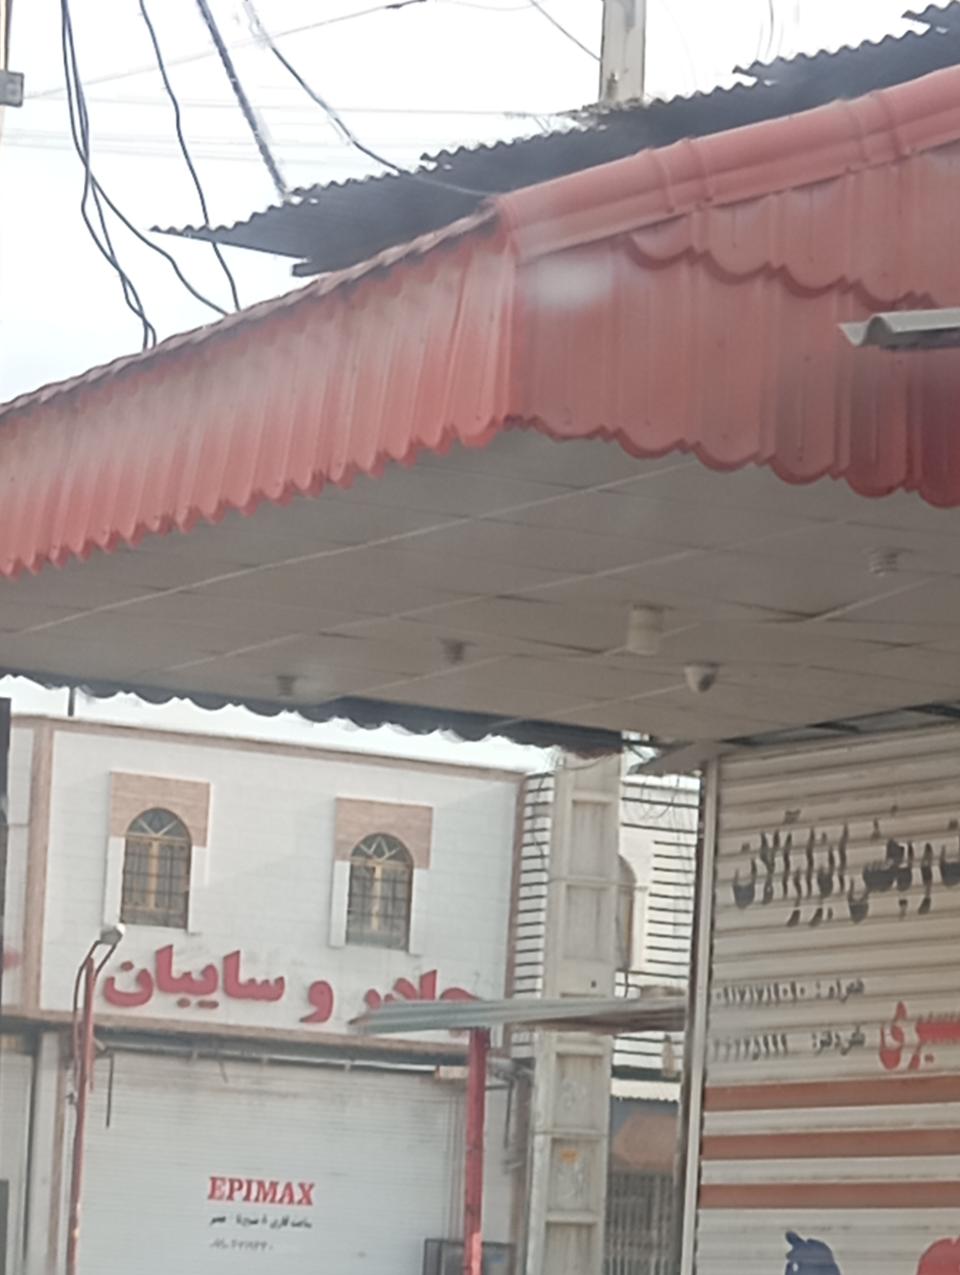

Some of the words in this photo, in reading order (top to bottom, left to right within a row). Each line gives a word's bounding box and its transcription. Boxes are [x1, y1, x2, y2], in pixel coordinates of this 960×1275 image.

[101, 943, 286, 1010] سایبان
[300, 978, 334, 1024] و
[207, 1176, 316, 1206] EPIMAX
